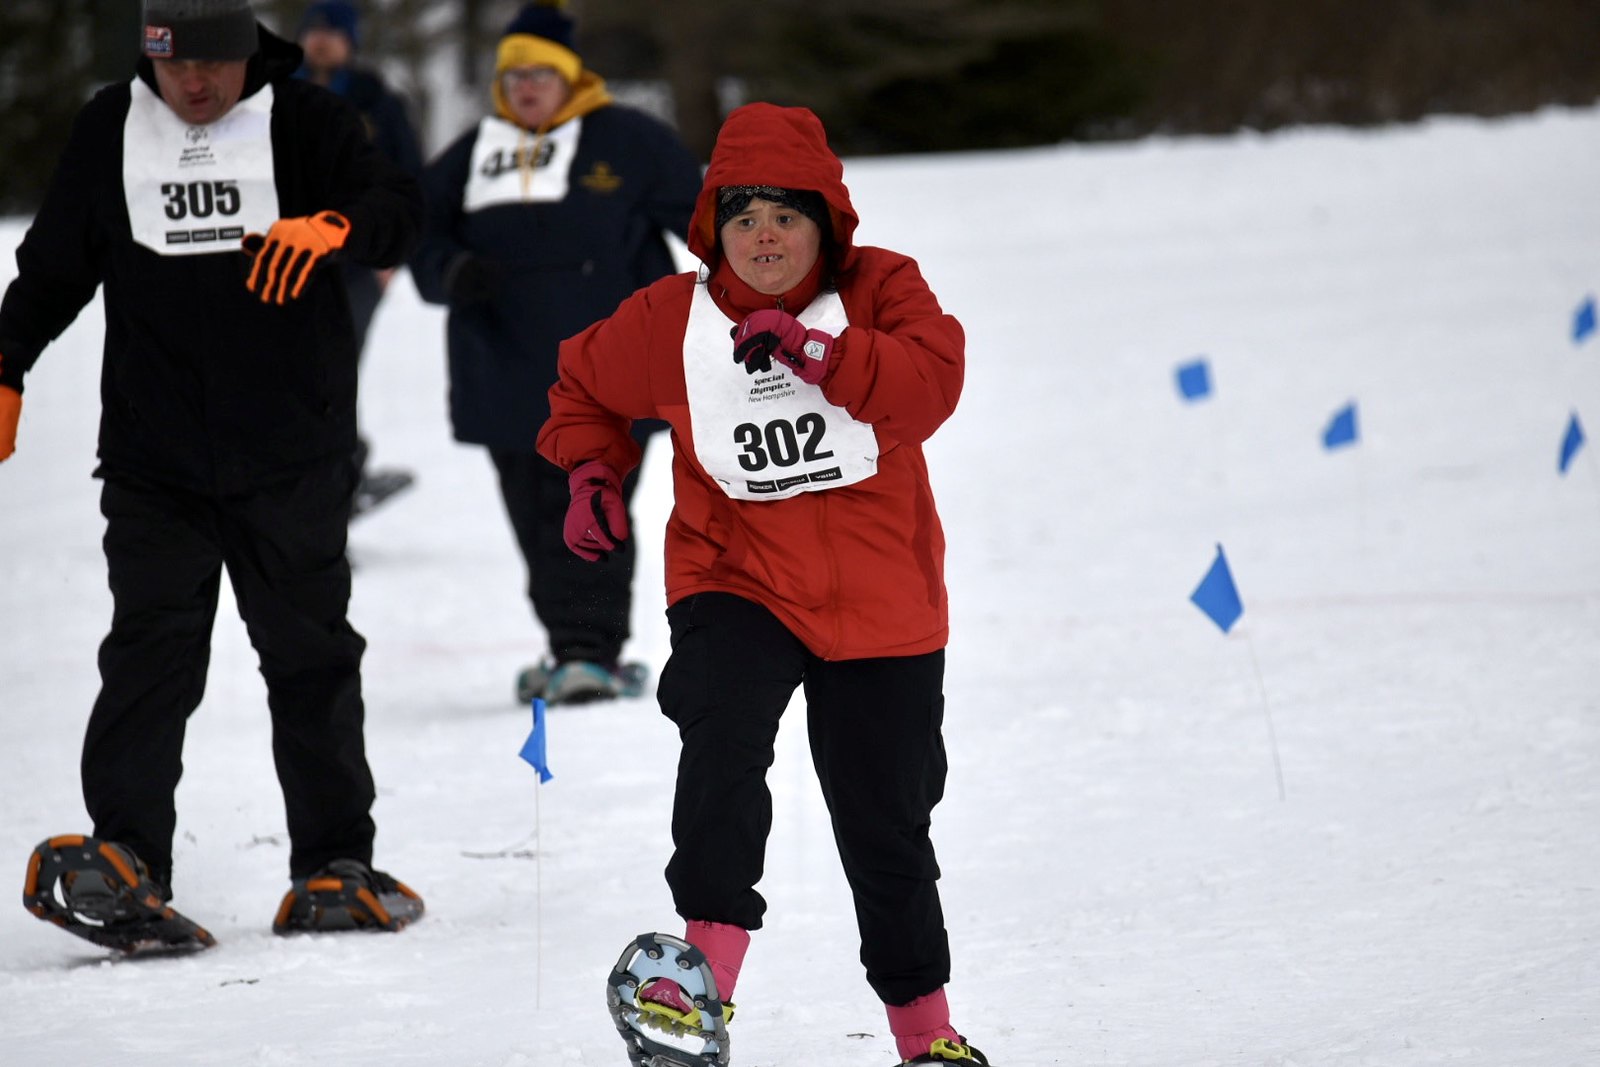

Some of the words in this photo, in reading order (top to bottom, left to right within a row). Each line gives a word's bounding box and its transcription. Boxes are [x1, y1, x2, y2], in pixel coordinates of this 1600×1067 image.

[161, 180, 241, 220] 305
[754, 373, 785, 386] Special
[750, 382, 791, 395] Olympics
[763, 389, 796, 401] Hampshire
[733, 412, 835, 472] 302
